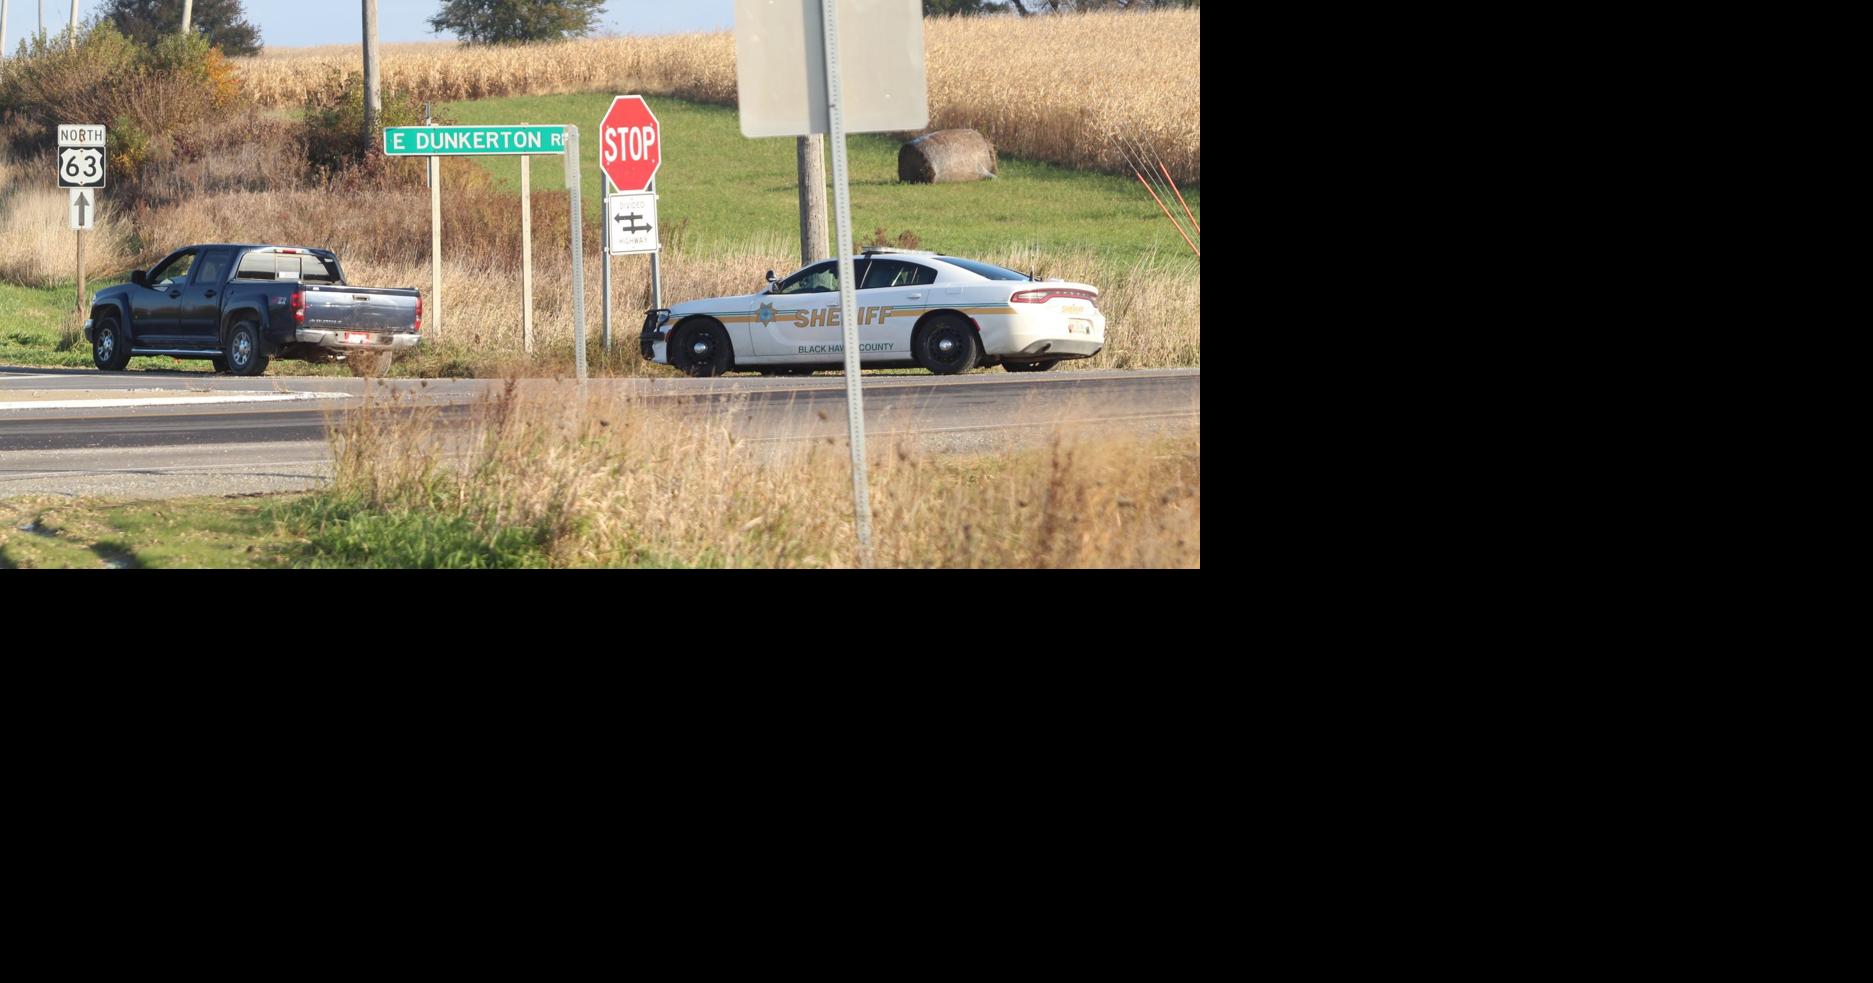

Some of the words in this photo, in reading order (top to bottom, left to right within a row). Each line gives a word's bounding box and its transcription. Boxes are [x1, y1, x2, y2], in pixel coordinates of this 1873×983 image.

[61, 130, 102, 141] NORTH
[394, 133, 405, 150] E
[416, 131, 541, 150] DUNKERTON
[605, 126, 656, 162] STOP
[66, 156, 96, 177] 63
[793, 306, 894, 328] SHEIFF
[798, 345, 826, 354] BLACK
[858, 343, 895, 352] COUNTY
